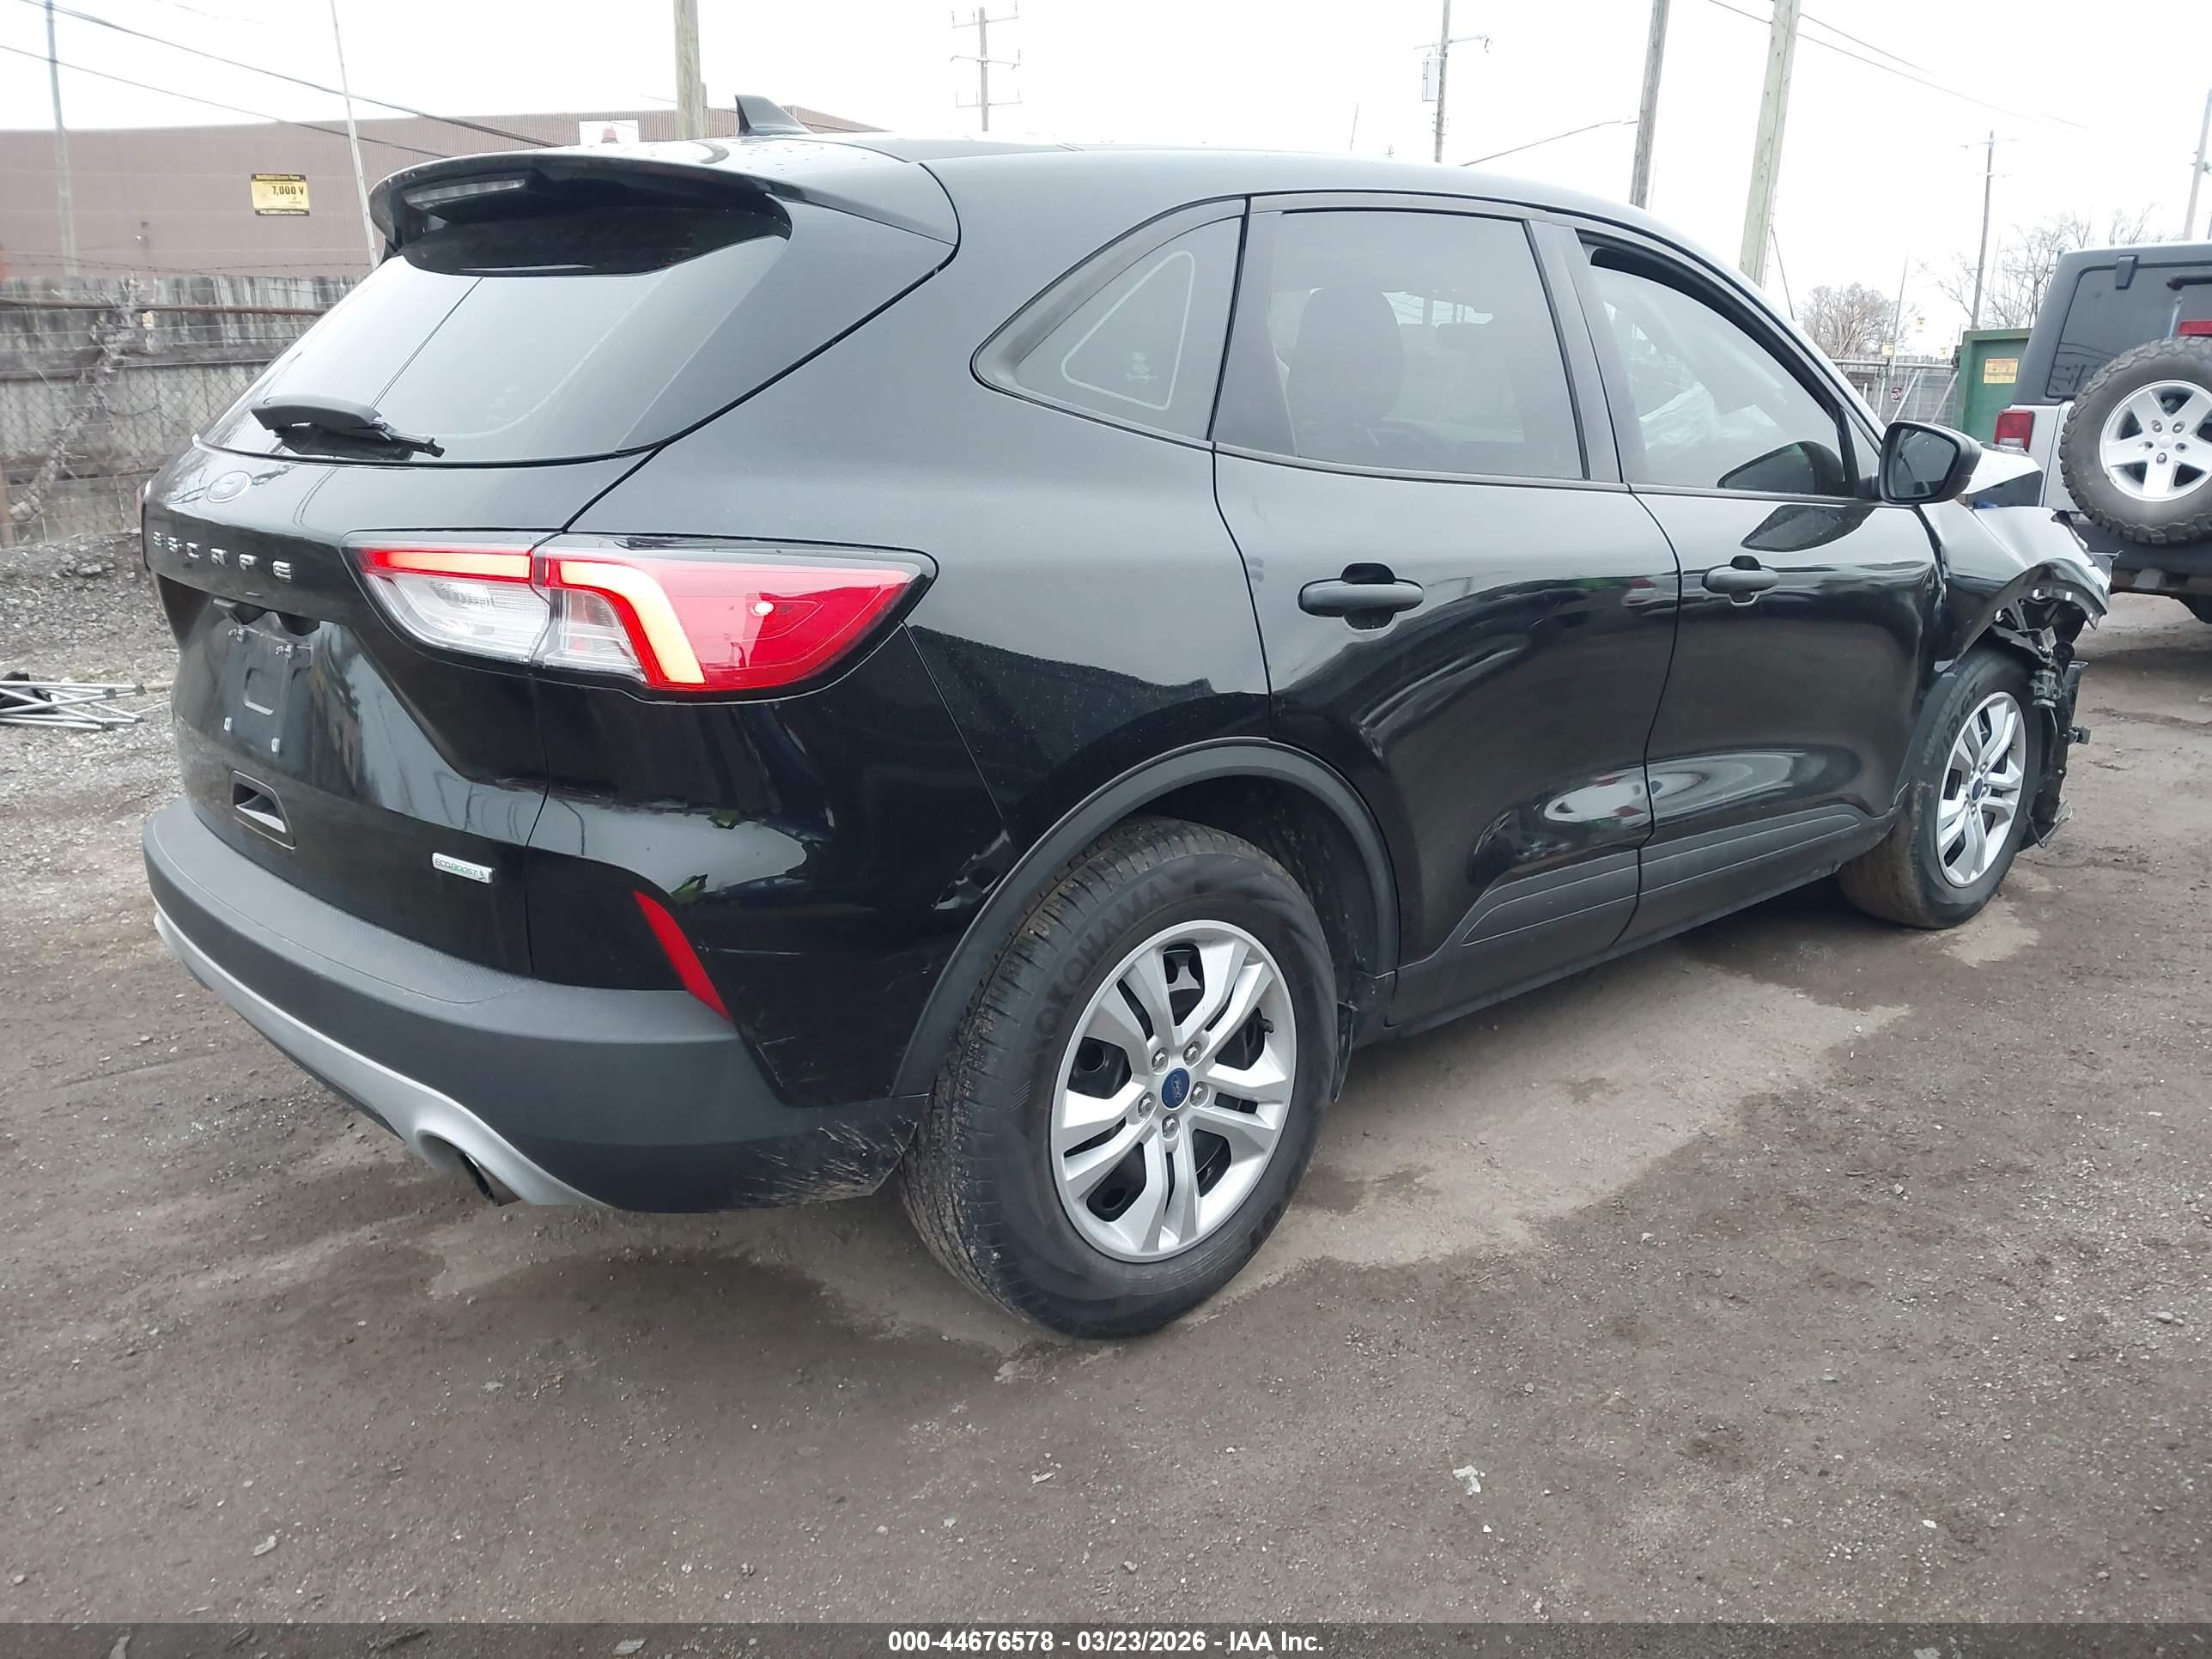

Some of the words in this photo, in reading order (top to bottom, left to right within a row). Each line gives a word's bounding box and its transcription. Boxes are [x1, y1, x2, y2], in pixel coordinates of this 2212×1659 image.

[271, 185, 296, 196] 7,000
[299, 185, 304, 195] V
[152, 531, 292, 583] ESCAPE
